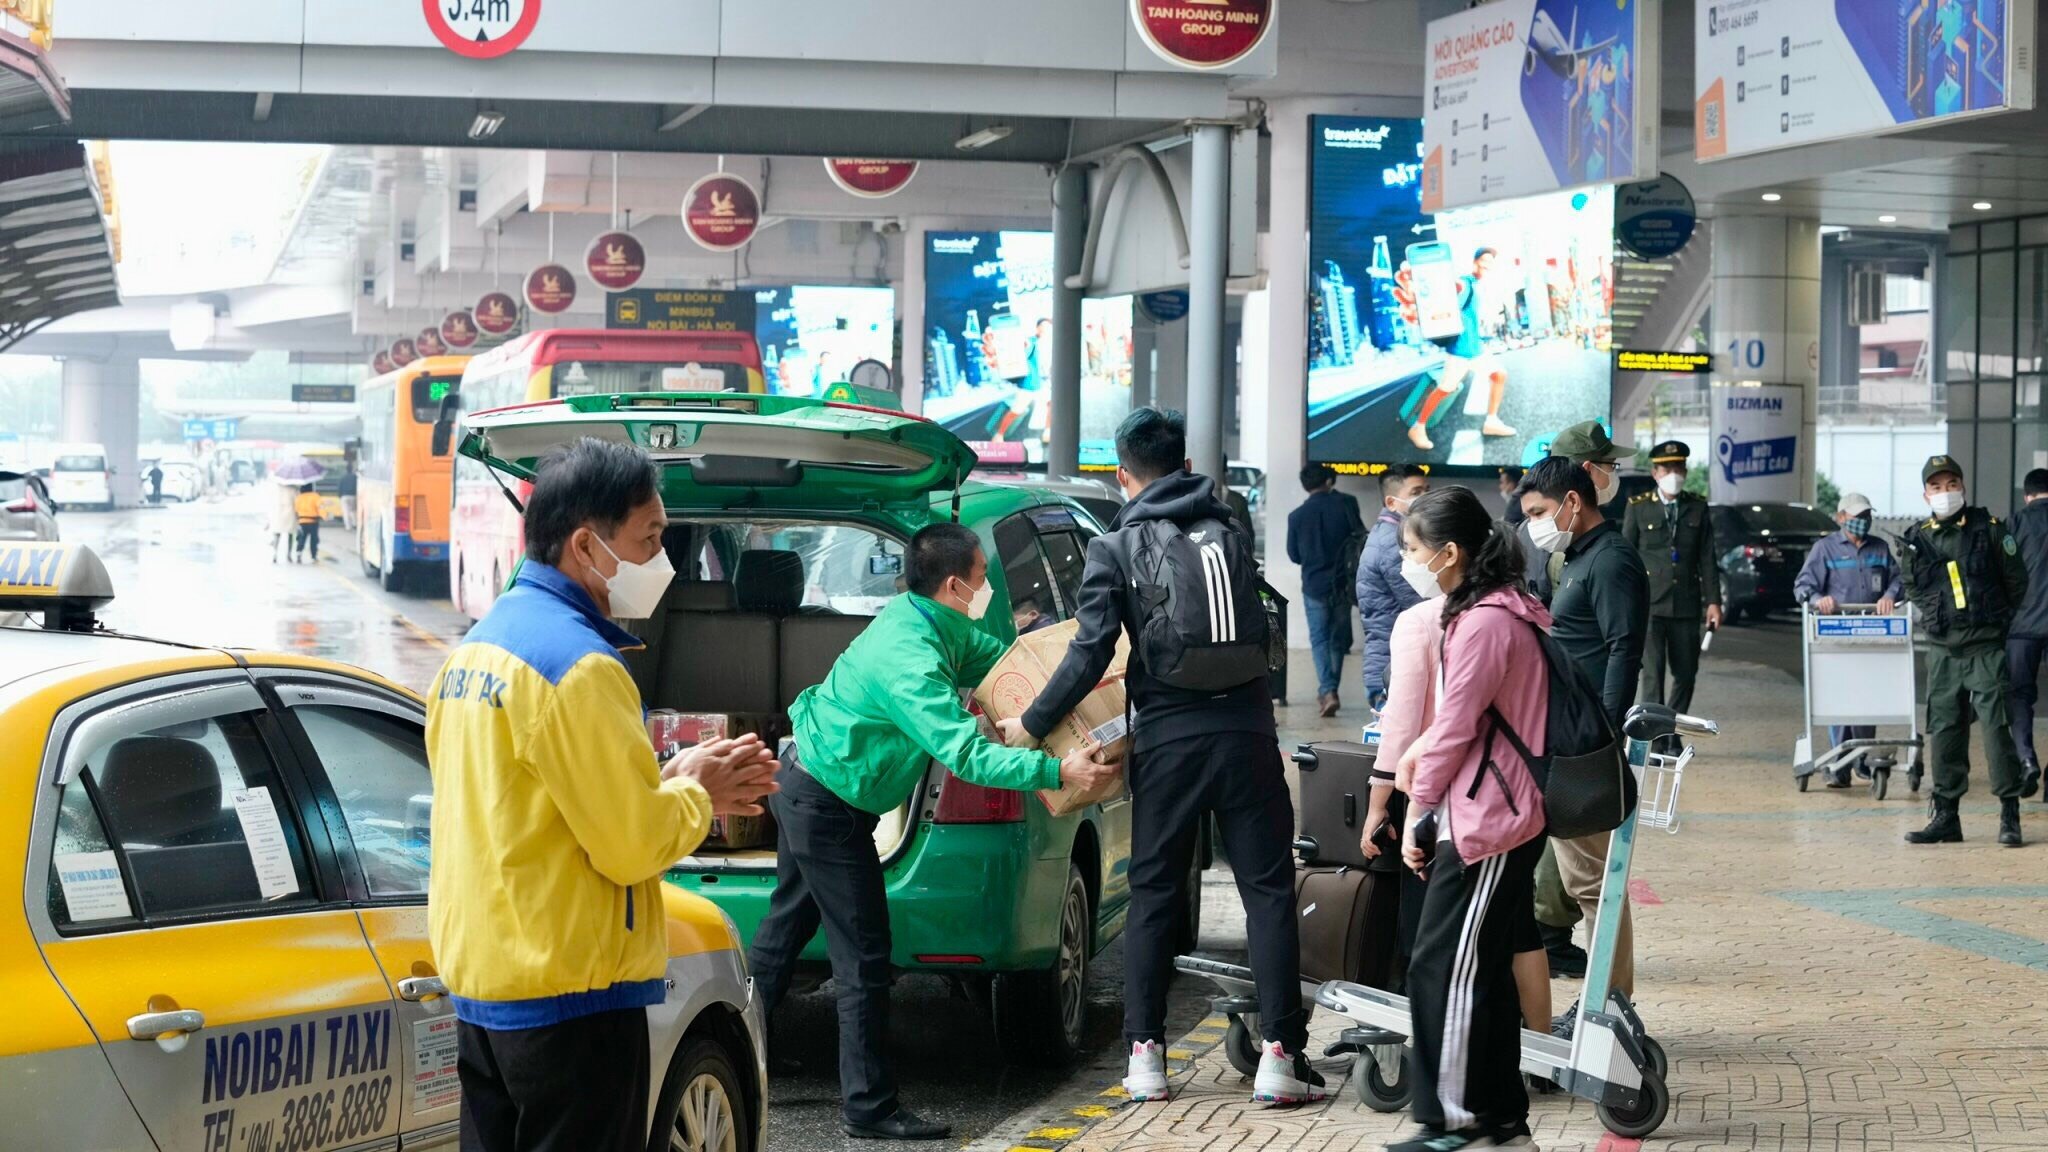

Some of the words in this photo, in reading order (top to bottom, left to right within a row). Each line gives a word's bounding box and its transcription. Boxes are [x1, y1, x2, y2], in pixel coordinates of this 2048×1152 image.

[1147, 6, 1173, 18] TAN
[1175, 7, 1223, 21] HOANG
[1225, 11, 1259, 24] MINH
[1181, 23, 1225, 35] GROUP
[1492, 17, 1514, 45] CÁO
[1728, 339, 1765, 368] 10
[1727, 397, 1782, 411] BIZMAN
[1751, 443, 1772, 458] MỜI
[1768, 455, 1789, 472] CÁO
[0, 549, 64, 586] AXI
[203, 1021, 316, 1104] NOIBAI
[327, 1009, 390, 1080] TAXI
[276, 1074, 392, 1152] 3886.8888
